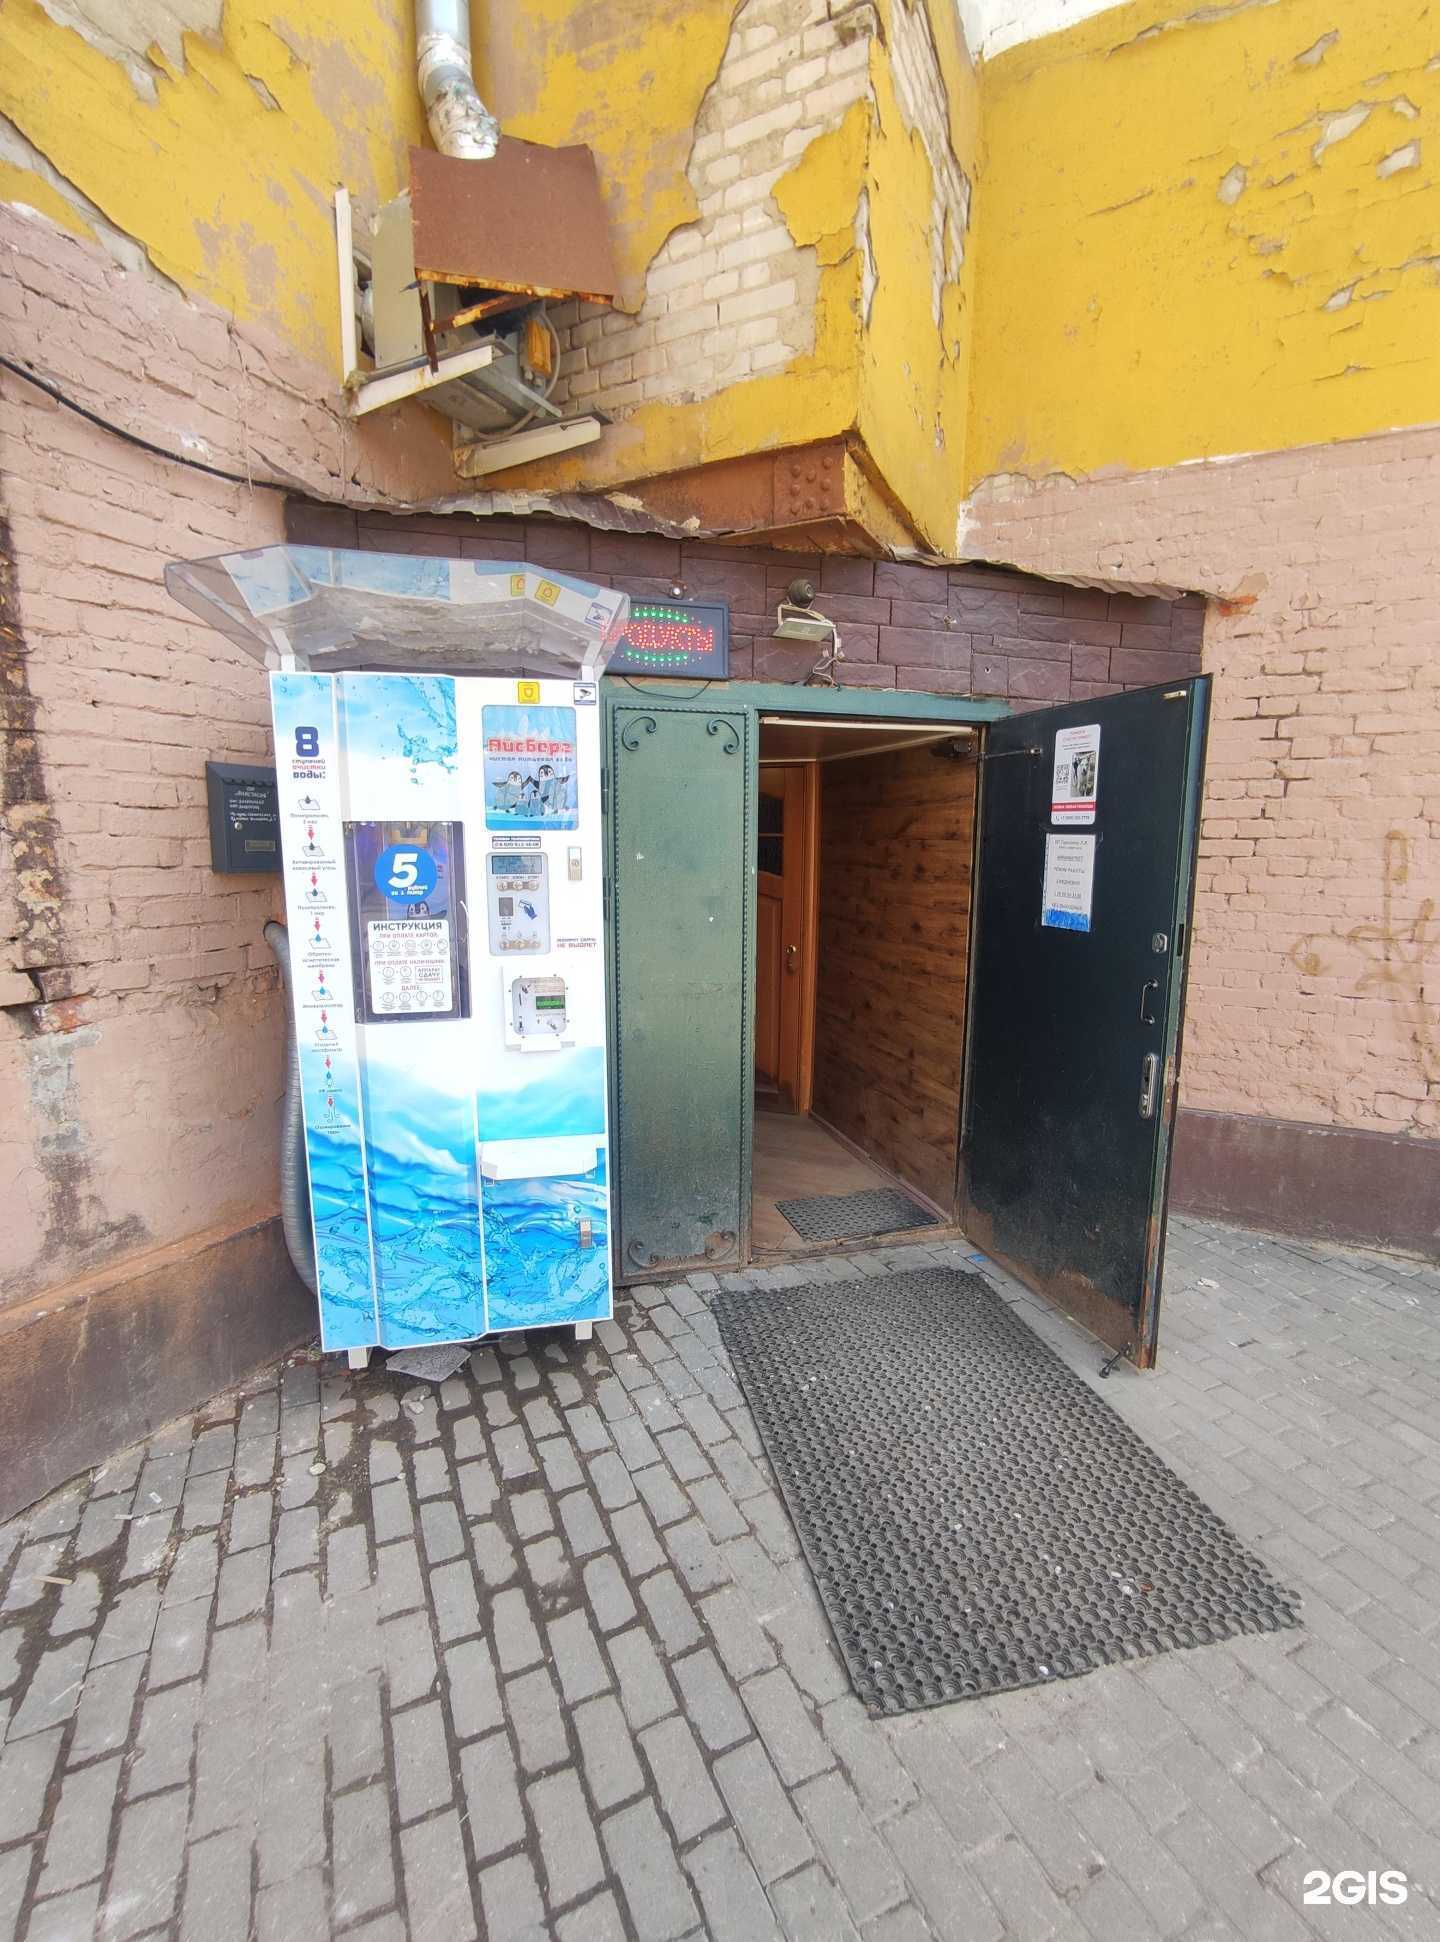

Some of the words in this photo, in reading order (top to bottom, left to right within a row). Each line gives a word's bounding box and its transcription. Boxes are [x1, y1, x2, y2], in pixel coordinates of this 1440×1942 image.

[294, 726, 320, 758] 8
[388, 852, 419, 889] 5
[373, 922, 442, 931] ИНСТРУКЦИЯ
